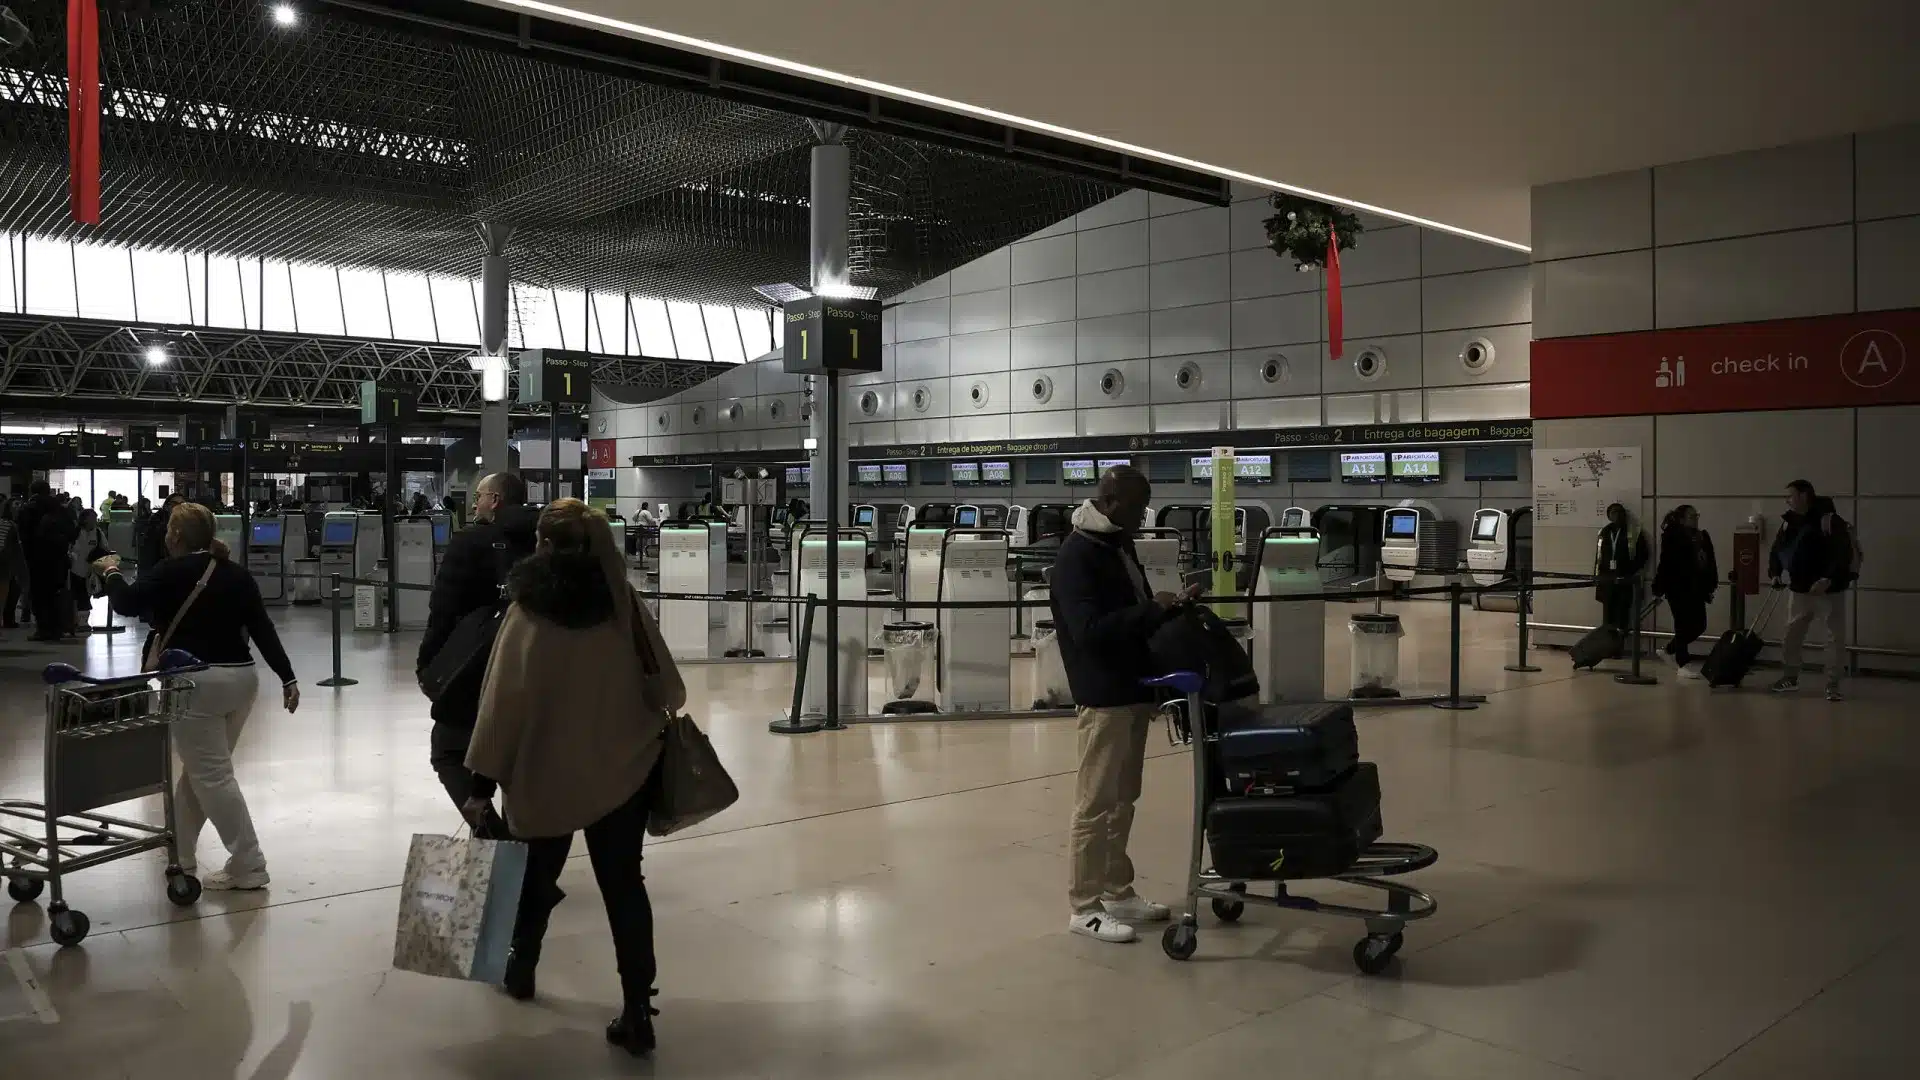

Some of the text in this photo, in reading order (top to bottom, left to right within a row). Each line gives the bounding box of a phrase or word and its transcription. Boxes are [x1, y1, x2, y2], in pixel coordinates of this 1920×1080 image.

[786, 309, 822, 324] Passo Step
[827, 306, 879, 323] Passo Step
[800, 329, 808, 360] 1
[849, 328, 859, 359] 1
[545, 357, 589, 369] Passo Step
[1711, 340, 1888, 375] check in A
[563, 372, 571, 396] 1
[392, 398, 399, 417] 1
[1275, 432, 1302, 443] Passo
[1309, 431, 1329, 442] Step
[1334, 428, 1343, 442] 2
[1364, 429, 1405, 441] Entrega
[1407, 427, 1422, 438] de
[1424, 426, 1480, 441] bagagem
[886, 448, 903, 456] Passo
[920, 445, 926, 456] 2
[937, 446, 960, 456] Entrega
[961, 445, 970, 453] de
[970, 444, 1003, 455] bagagem
[1006, 443, 1033, 454] Baggage
[1033, 442, 1049, 453] drop
[958, 470, 973, 480] A07
[989, 470, 1005, 480] A08
[1071, 468, 1088, 478] A09
[1240, 465, 1262, 475] A12
[1351, 463, 1376, 474] A13
[1403, 463, 1429, 474] A14
